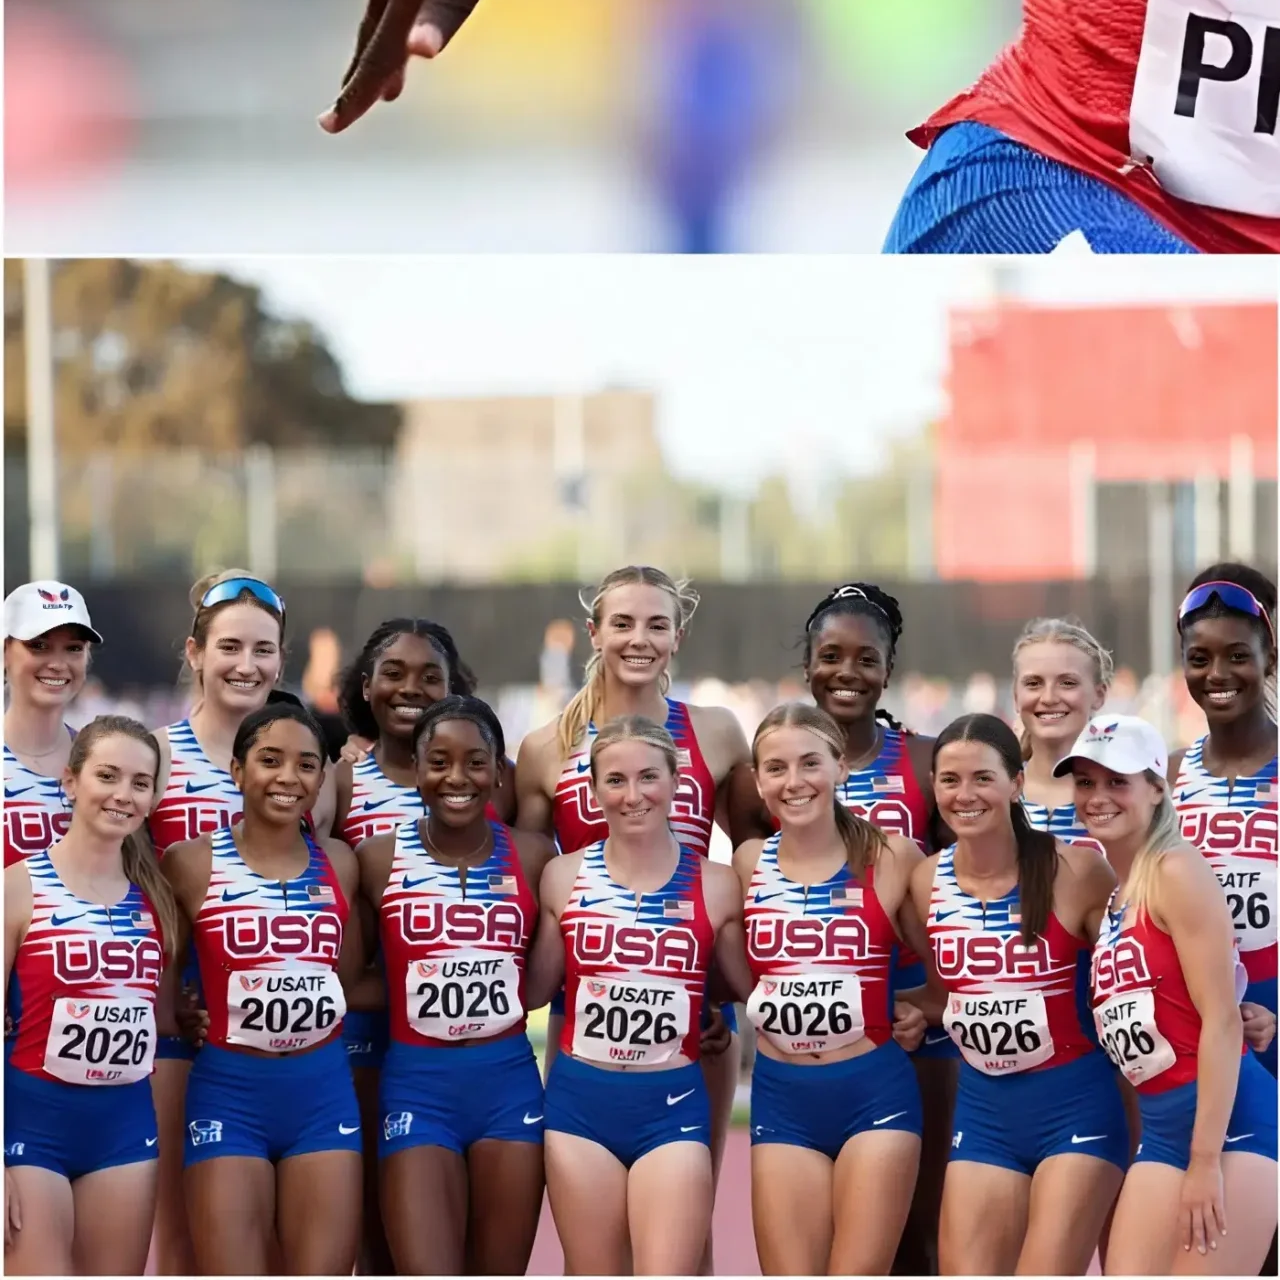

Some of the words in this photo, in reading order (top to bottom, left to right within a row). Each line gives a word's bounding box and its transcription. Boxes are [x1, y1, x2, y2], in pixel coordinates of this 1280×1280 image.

[223, 912, 343, 960] USA
[401, 903, 524, 946] USA
[748, 916, 870, 961] USA
[53, 938, 163, 985] USA
[574, 921, 699, 972] USA
[936, 933, 1051, 980] USA
[266, 976, 326, 994] USATF
[441, 958, 504, 978] USATF
[416, 980, 511, 1020] 2026
[609, 984, 676, 1008] USATF
[780, 979, 844, 998] USATF
[964, 998, 1028, 1017] USATF
[94, 1005, 149, 1025] USATF
[240, 996, 337, 1033] 2026
[584, 1002, 678, 1046] 2026
[758, 1001, 852, 1037] 2026
[58, 1023, 150, 1066] 2026
[950, 1019, 1041, 1056] 2026
